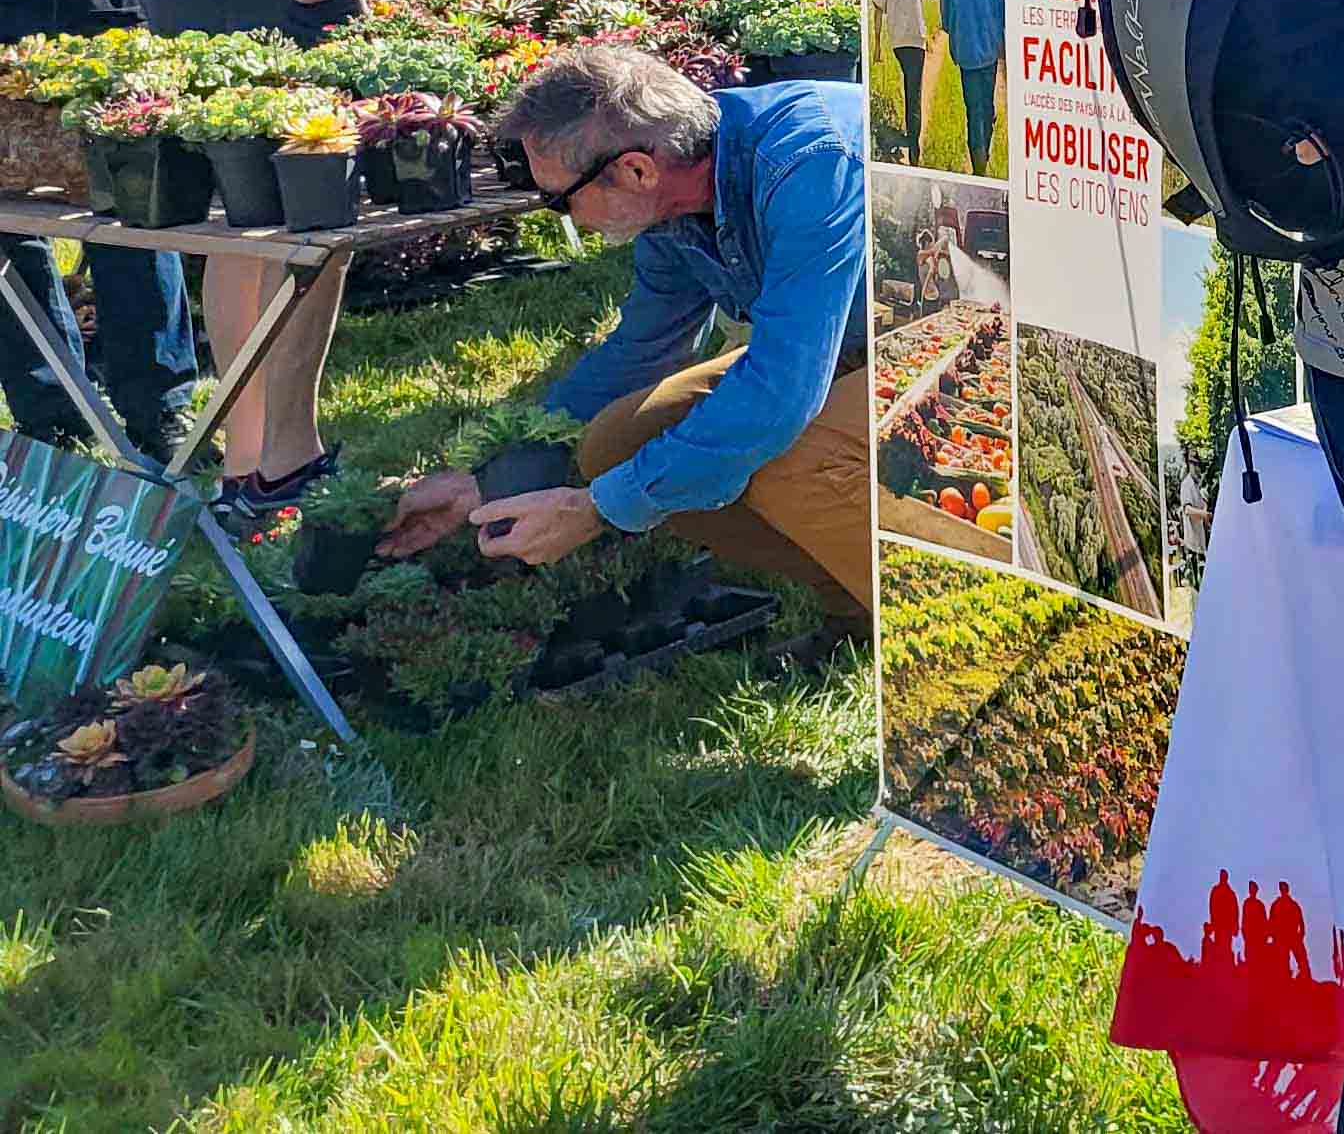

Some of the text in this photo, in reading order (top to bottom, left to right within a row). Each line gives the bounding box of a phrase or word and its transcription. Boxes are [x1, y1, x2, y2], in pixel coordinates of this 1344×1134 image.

[1022, 5, 1077, 30] LES TERR
[1057, 97, 1073, 113] DES
[1024, 117, 1150, 184] MOBILISER
[1025, 169, 1150, 227] LES CITOYENS
